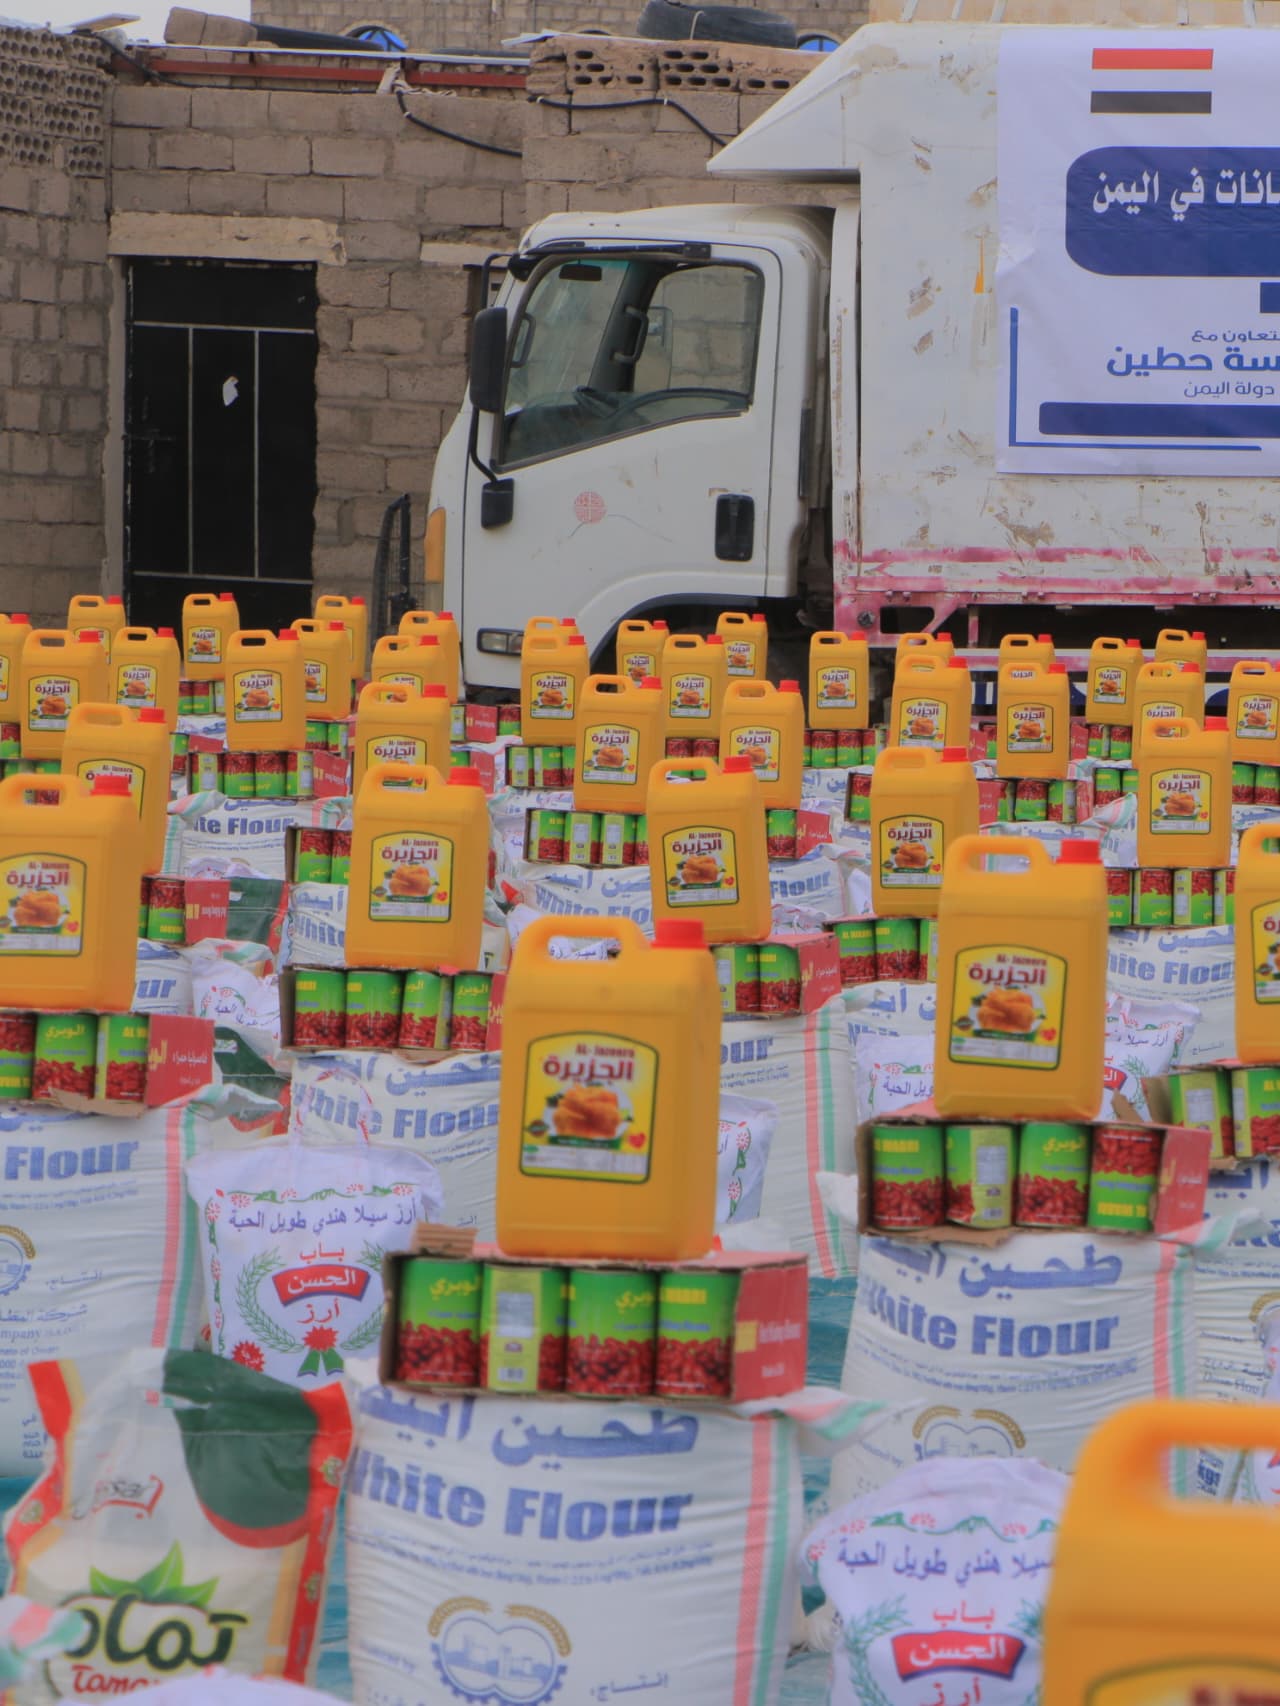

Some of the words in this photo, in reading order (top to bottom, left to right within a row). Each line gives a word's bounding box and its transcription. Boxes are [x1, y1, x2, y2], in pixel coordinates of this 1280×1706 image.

[1093, 170, 1159, 214] اليمن
[1170, 167, 1205, 221] في
[1191, 330, 1219, 343] مع
[1106, 344, 1216, 376] حطين
[1183, 381, 1231, 399] اليمن
[1234, 381, 1275, 400] دولة
[591, 734, 631, 746] الجزيرة
[1157, 779, 1201, 792] الجزيرة
[227, 815, 295, 837] Flour
[887, 826, 933, 842] الجزيرة
[382, 847, 438, 865] الجزيرة
[671, 838, 723, 855] الجزيرة
[7, 871, 70, 891] الجزيرة
[968, 962, 1047, 987] الجزيرة
[543, 1056, 635, 1084] الجزيرة
[4, 1141, 140, 1180] Flour
[228, 1208, 265, 1233] الحبة
[269, 1211, 307, 1235] طويل
[312, 1207, 348, 1236] هندي
[355, 1204, 388, 1228] سيلا
[394, 1198, 416, 1225] أرز
[299, 1241, 346, 1265] باب
[286, 1268, 357, 1296] الحسن
[959, 1243, 1123, 1300] طحين
[297, 1298, 340, 1325] أرز
[971, 1314, 1120, 1358] Flour
[492, 1408, 699, 1472] طحين
[504, 1486, 694, 1541] Flour
[837, 1536, 886, 1574] الحبة
[893, 1544, 947, 1581] طويل
[955, 1548, 1002, 1588] هندي
[932, 1599, 996, 1631] باب
[909, 1636, 1006, 1668] الحسن
